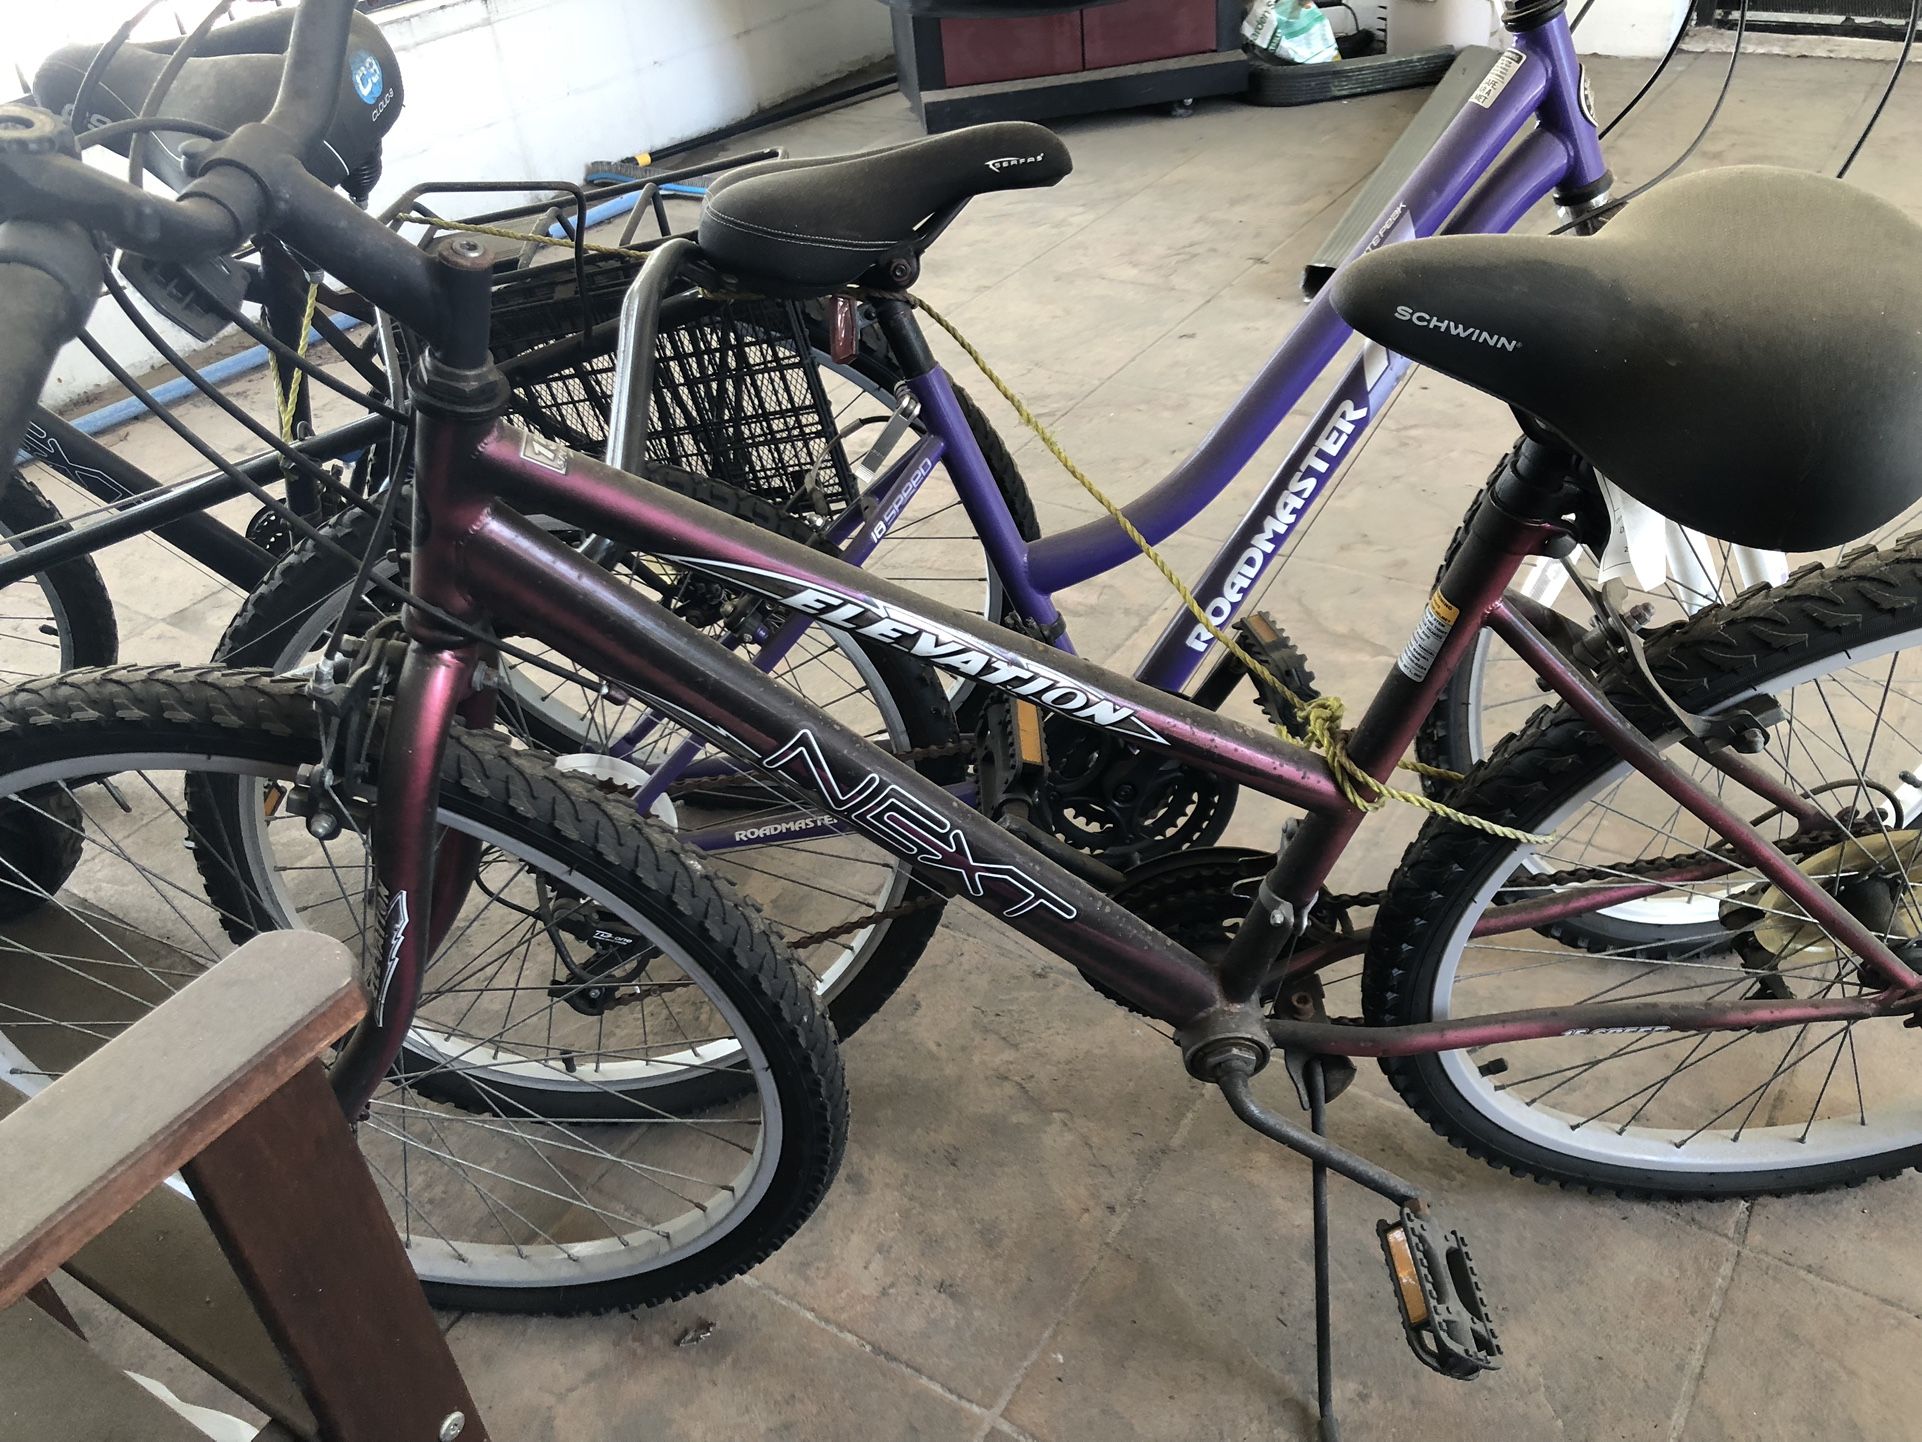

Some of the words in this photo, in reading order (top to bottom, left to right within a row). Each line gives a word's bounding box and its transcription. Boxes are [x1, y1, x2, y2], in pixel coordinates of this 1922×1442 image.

[1250, 9, 1272, 43] arden
[1185, 400, 1368, 652] ROADMASTER
[780, 589, 1135, 727] ELEVATION
[735, 814, 838, 842] ROADMASTE
[763, 728, 1077, 920] NEXT
